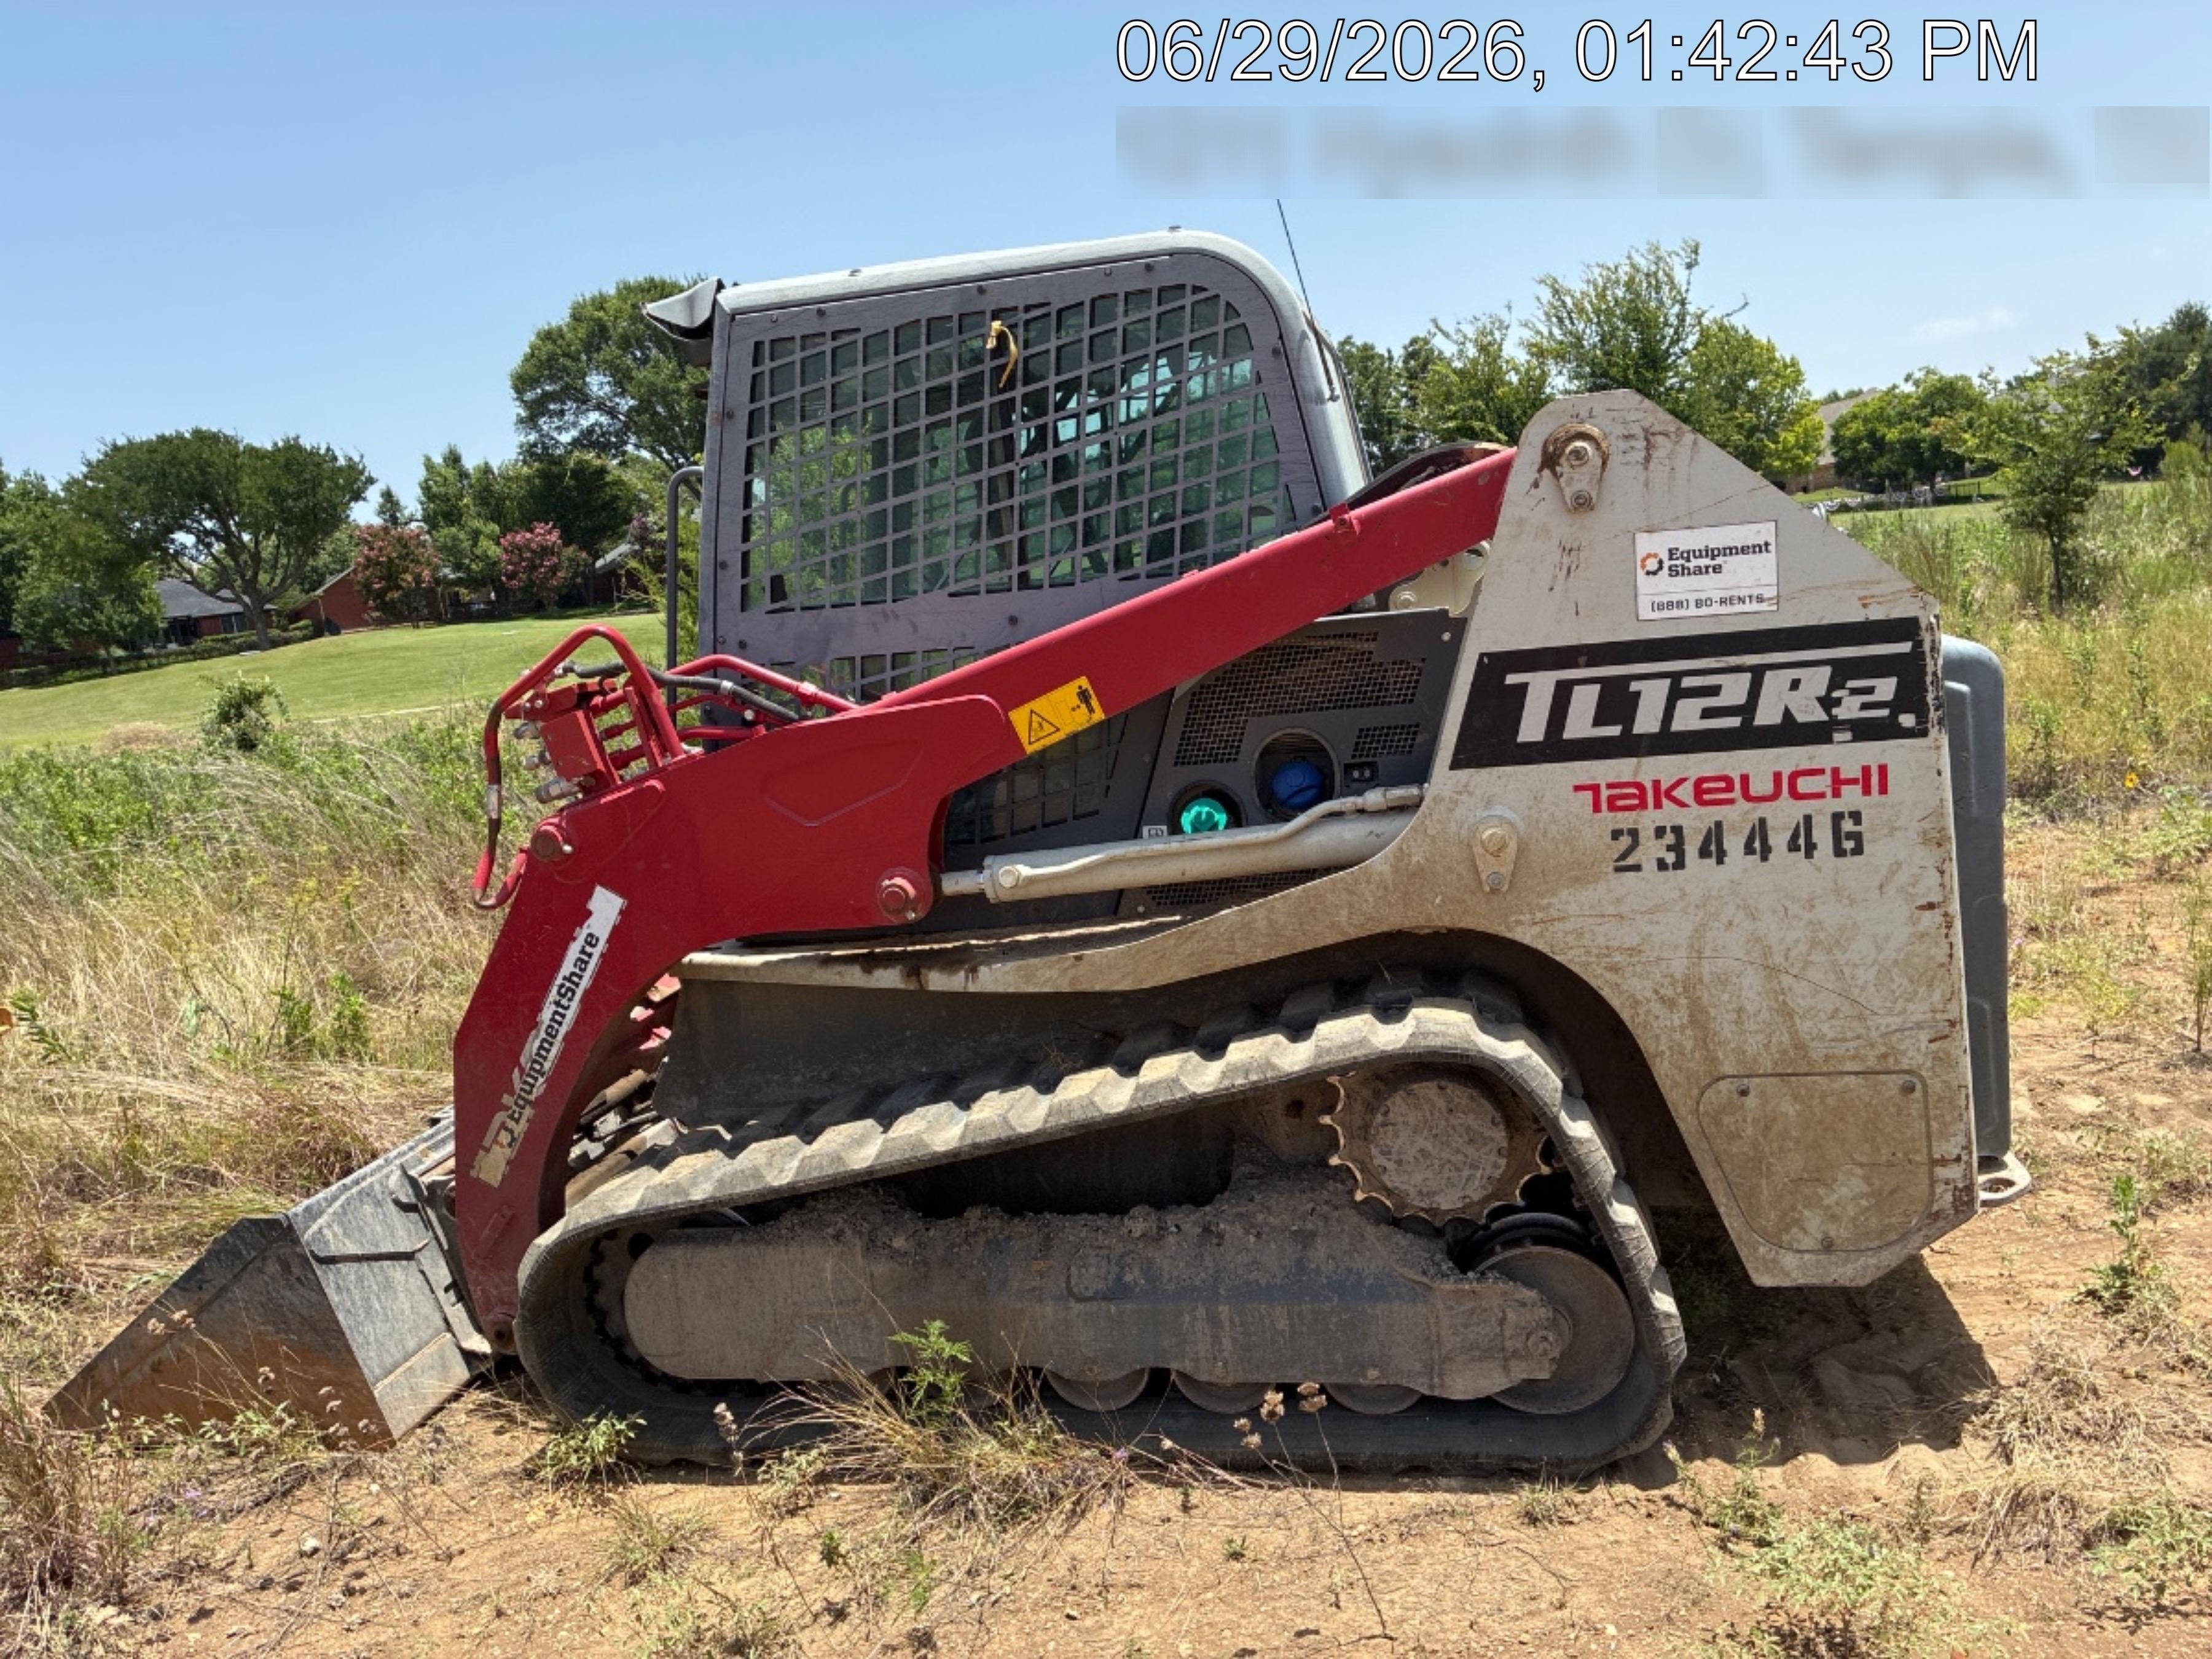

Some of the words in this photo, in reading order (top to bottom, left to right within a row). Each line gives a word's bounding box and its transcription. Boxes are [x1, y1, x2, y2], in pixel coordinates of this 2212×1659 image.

[1668, 541, 1772, 563] Equipment
[1668, 563, 1723, 578] Share
[1610, 810, 1864, 873] 234446
